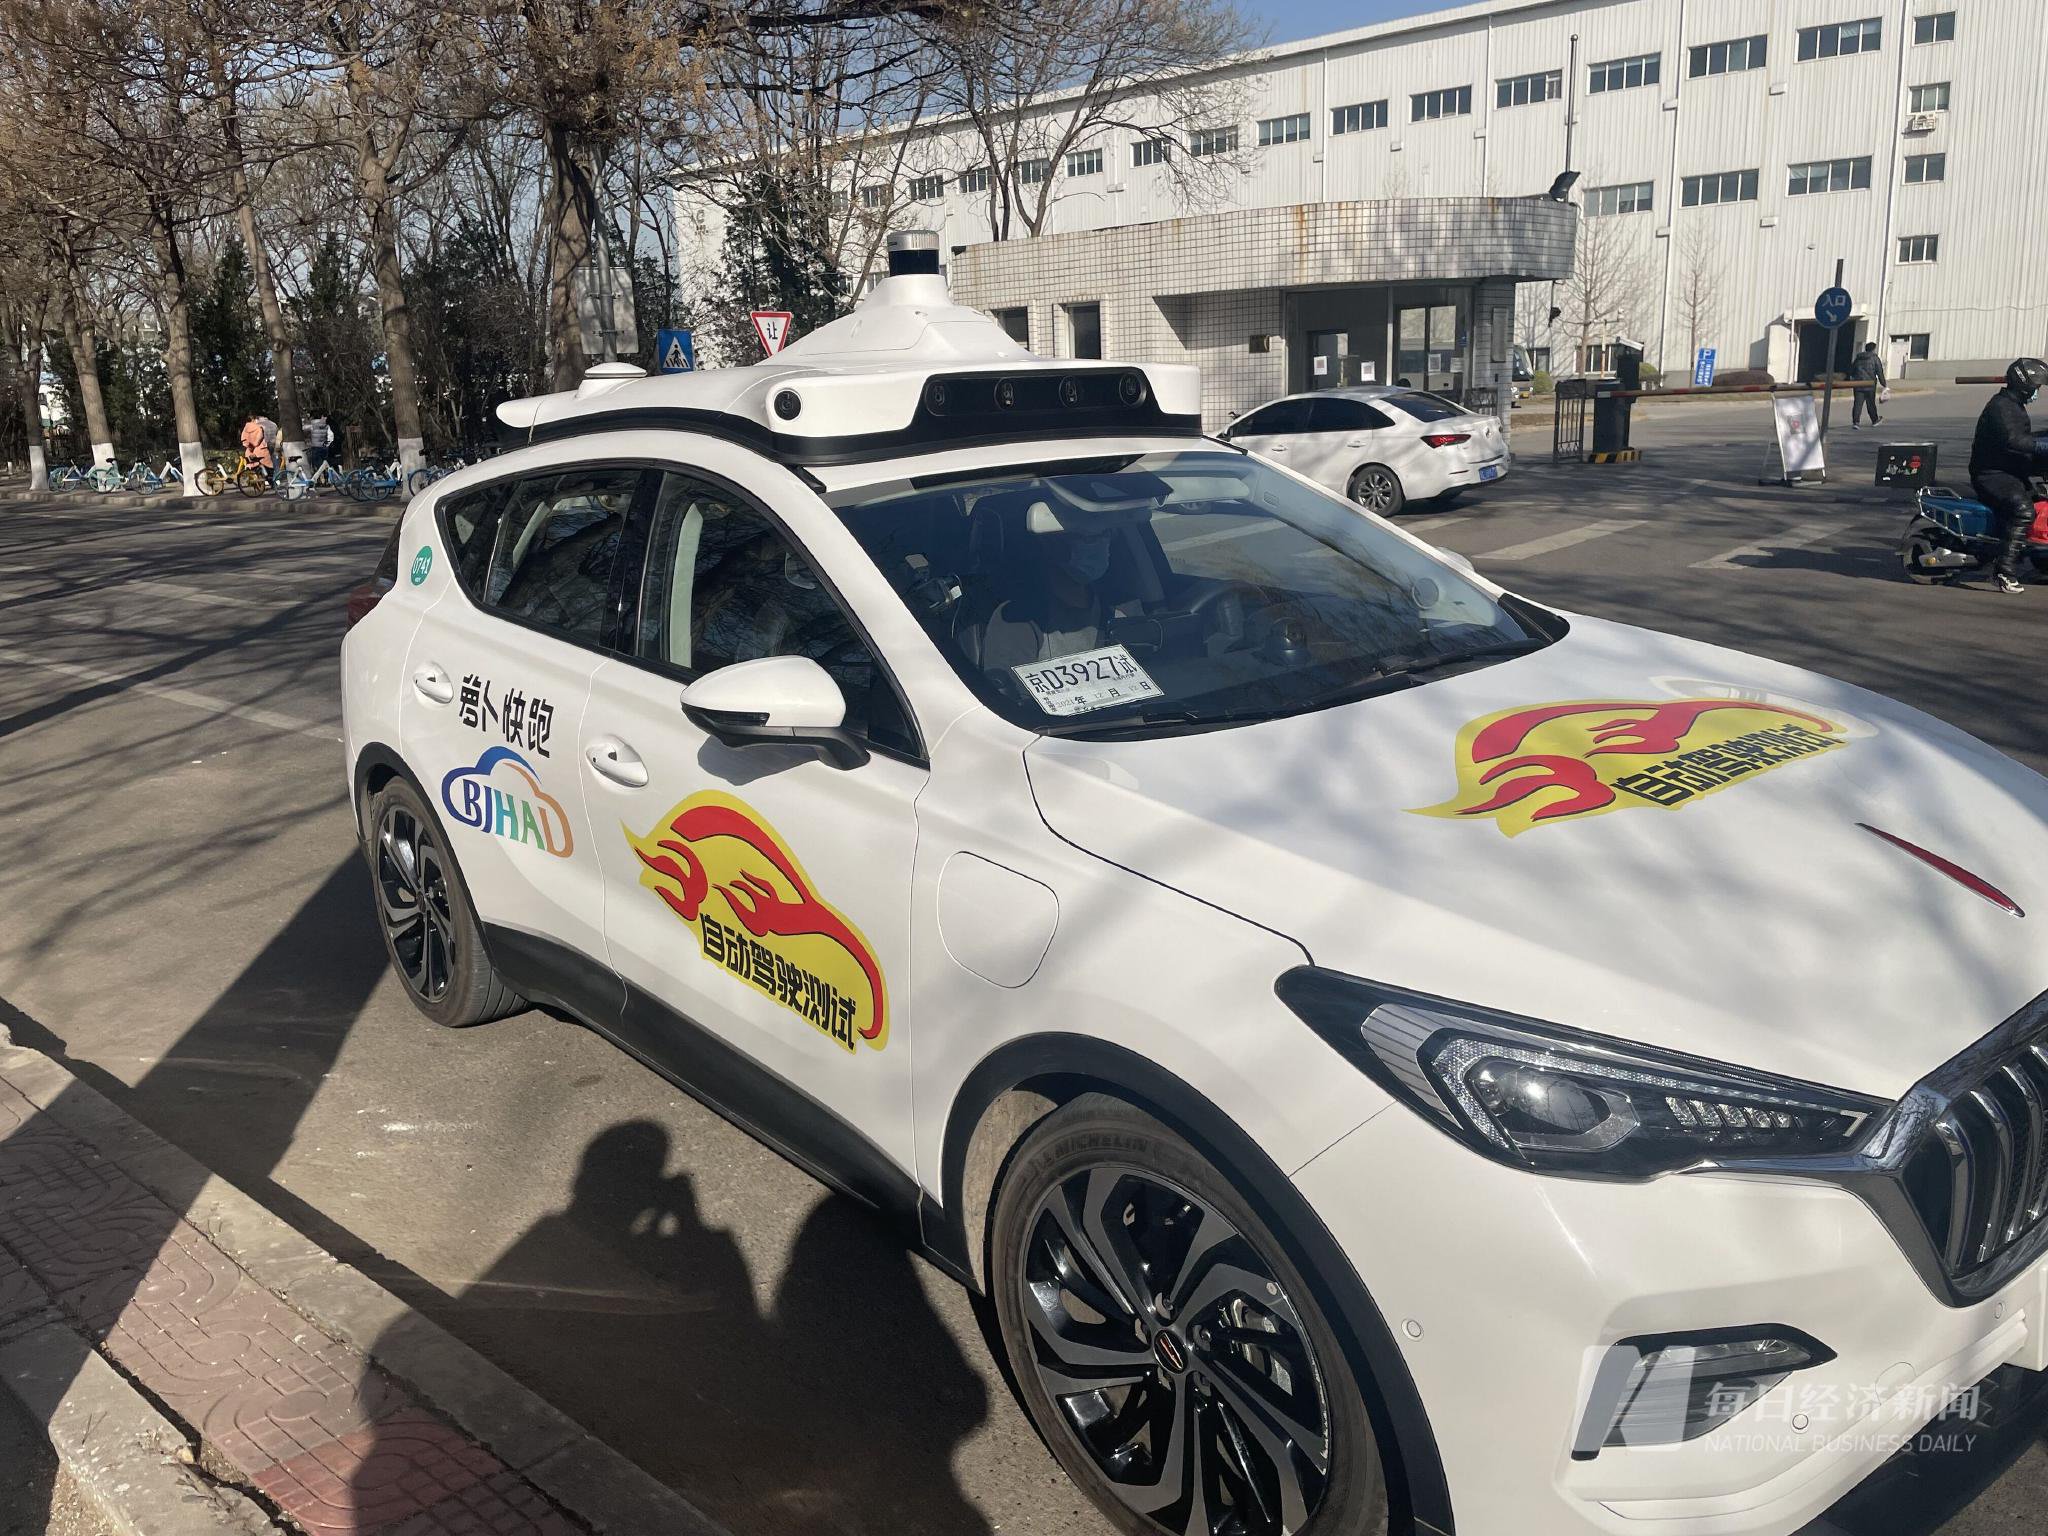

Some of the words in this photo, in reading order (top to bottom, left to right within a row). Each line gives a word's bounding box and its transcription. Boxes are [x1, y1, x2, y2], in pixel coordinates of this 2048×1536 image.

[767, 321, 778, 340] 让
[1822, 294, 1846, 307] 入口
[1025, 654, 1138, 693] 京D3927试
[459, 674, 554, 759] 萝卜快跑
[1610, 723, 1845, 806] 自动驾驶测试
[700, 913, 857, 1051] 自动驾驶测试
